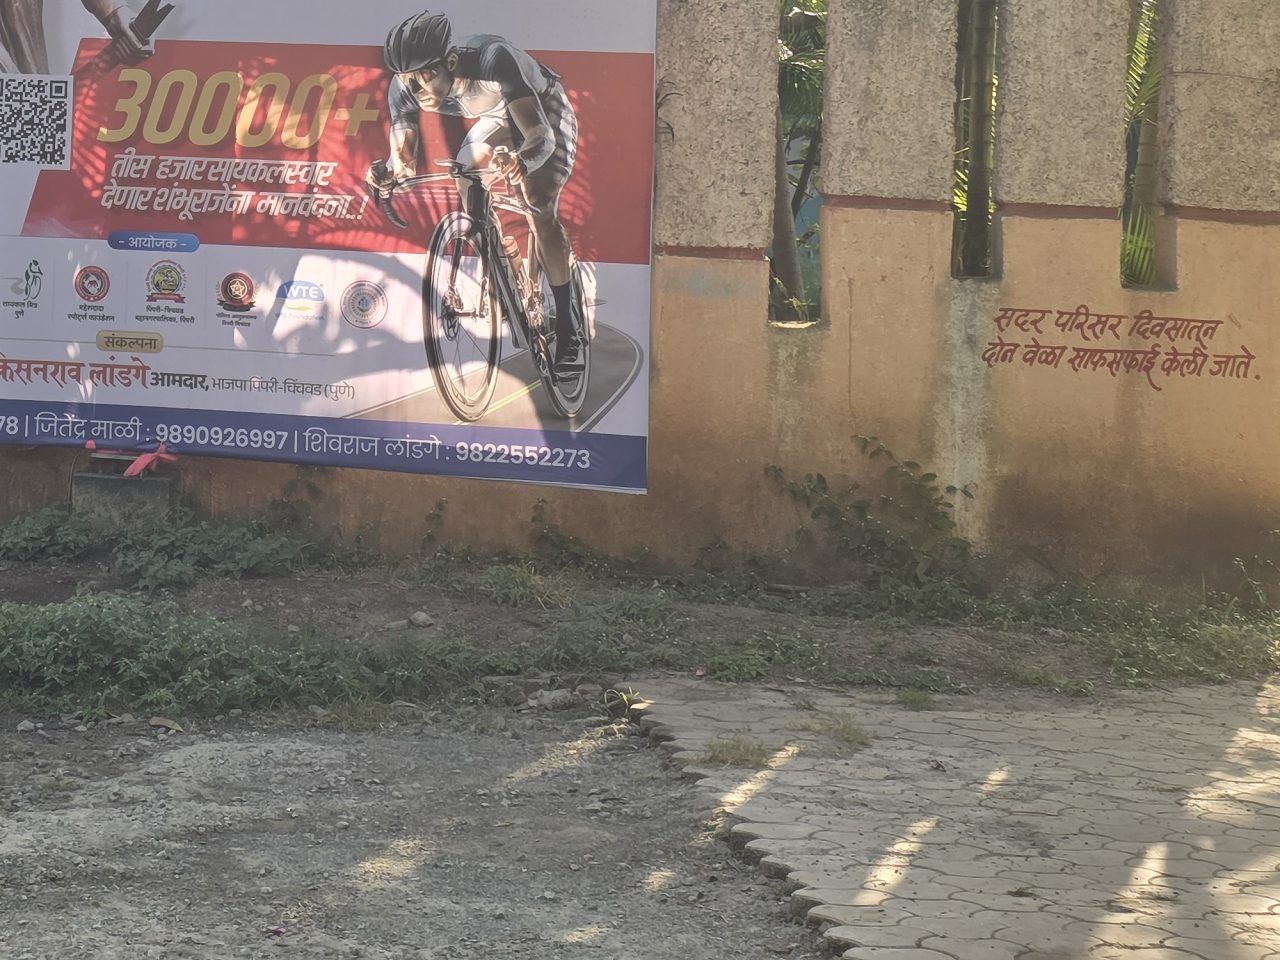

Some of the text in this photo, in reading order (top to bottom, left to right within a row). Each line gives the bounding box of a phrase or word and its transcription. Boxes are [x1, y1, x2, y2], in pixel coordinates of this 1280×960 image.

[97, 68, 381, 151] 30000+
[110, 146, 338, 187] तीस हजार सायकलस्वार
[100, 178, 157, 211] देणार
[152, 181, 256, 222] शंभूराजेंना
[128, 234, 179, 249] आयोजक
[283, 284, 319, 299] WTE
[103, 333, 158, 350] संकल्पना
[993, 307, 1053, 335] सदर
[1053, 304, 1129, 341] परिसर
[88, 354, 152, 389] लांडगे
[150, 371, 210, 392] आमदार,
[211, 376, 247, 393] भाजपा
[981, 336, 1021, 369] दोन
[1021, 337, 1069, 369] वेळा
[1067, 342, 1163, 392] साफसफाई
[1160, 346, 1210, 378] केली
[33, 410, 88, 439] जितेंद्र
[90, 416, 143, 441] माळी
[155, 423, 289, 451] 9890926997
[302, 426, 382, 457] शिवराज
[382, 434, 443, 461] लांडगे
[455, 440, 591, 470] 9822552273
